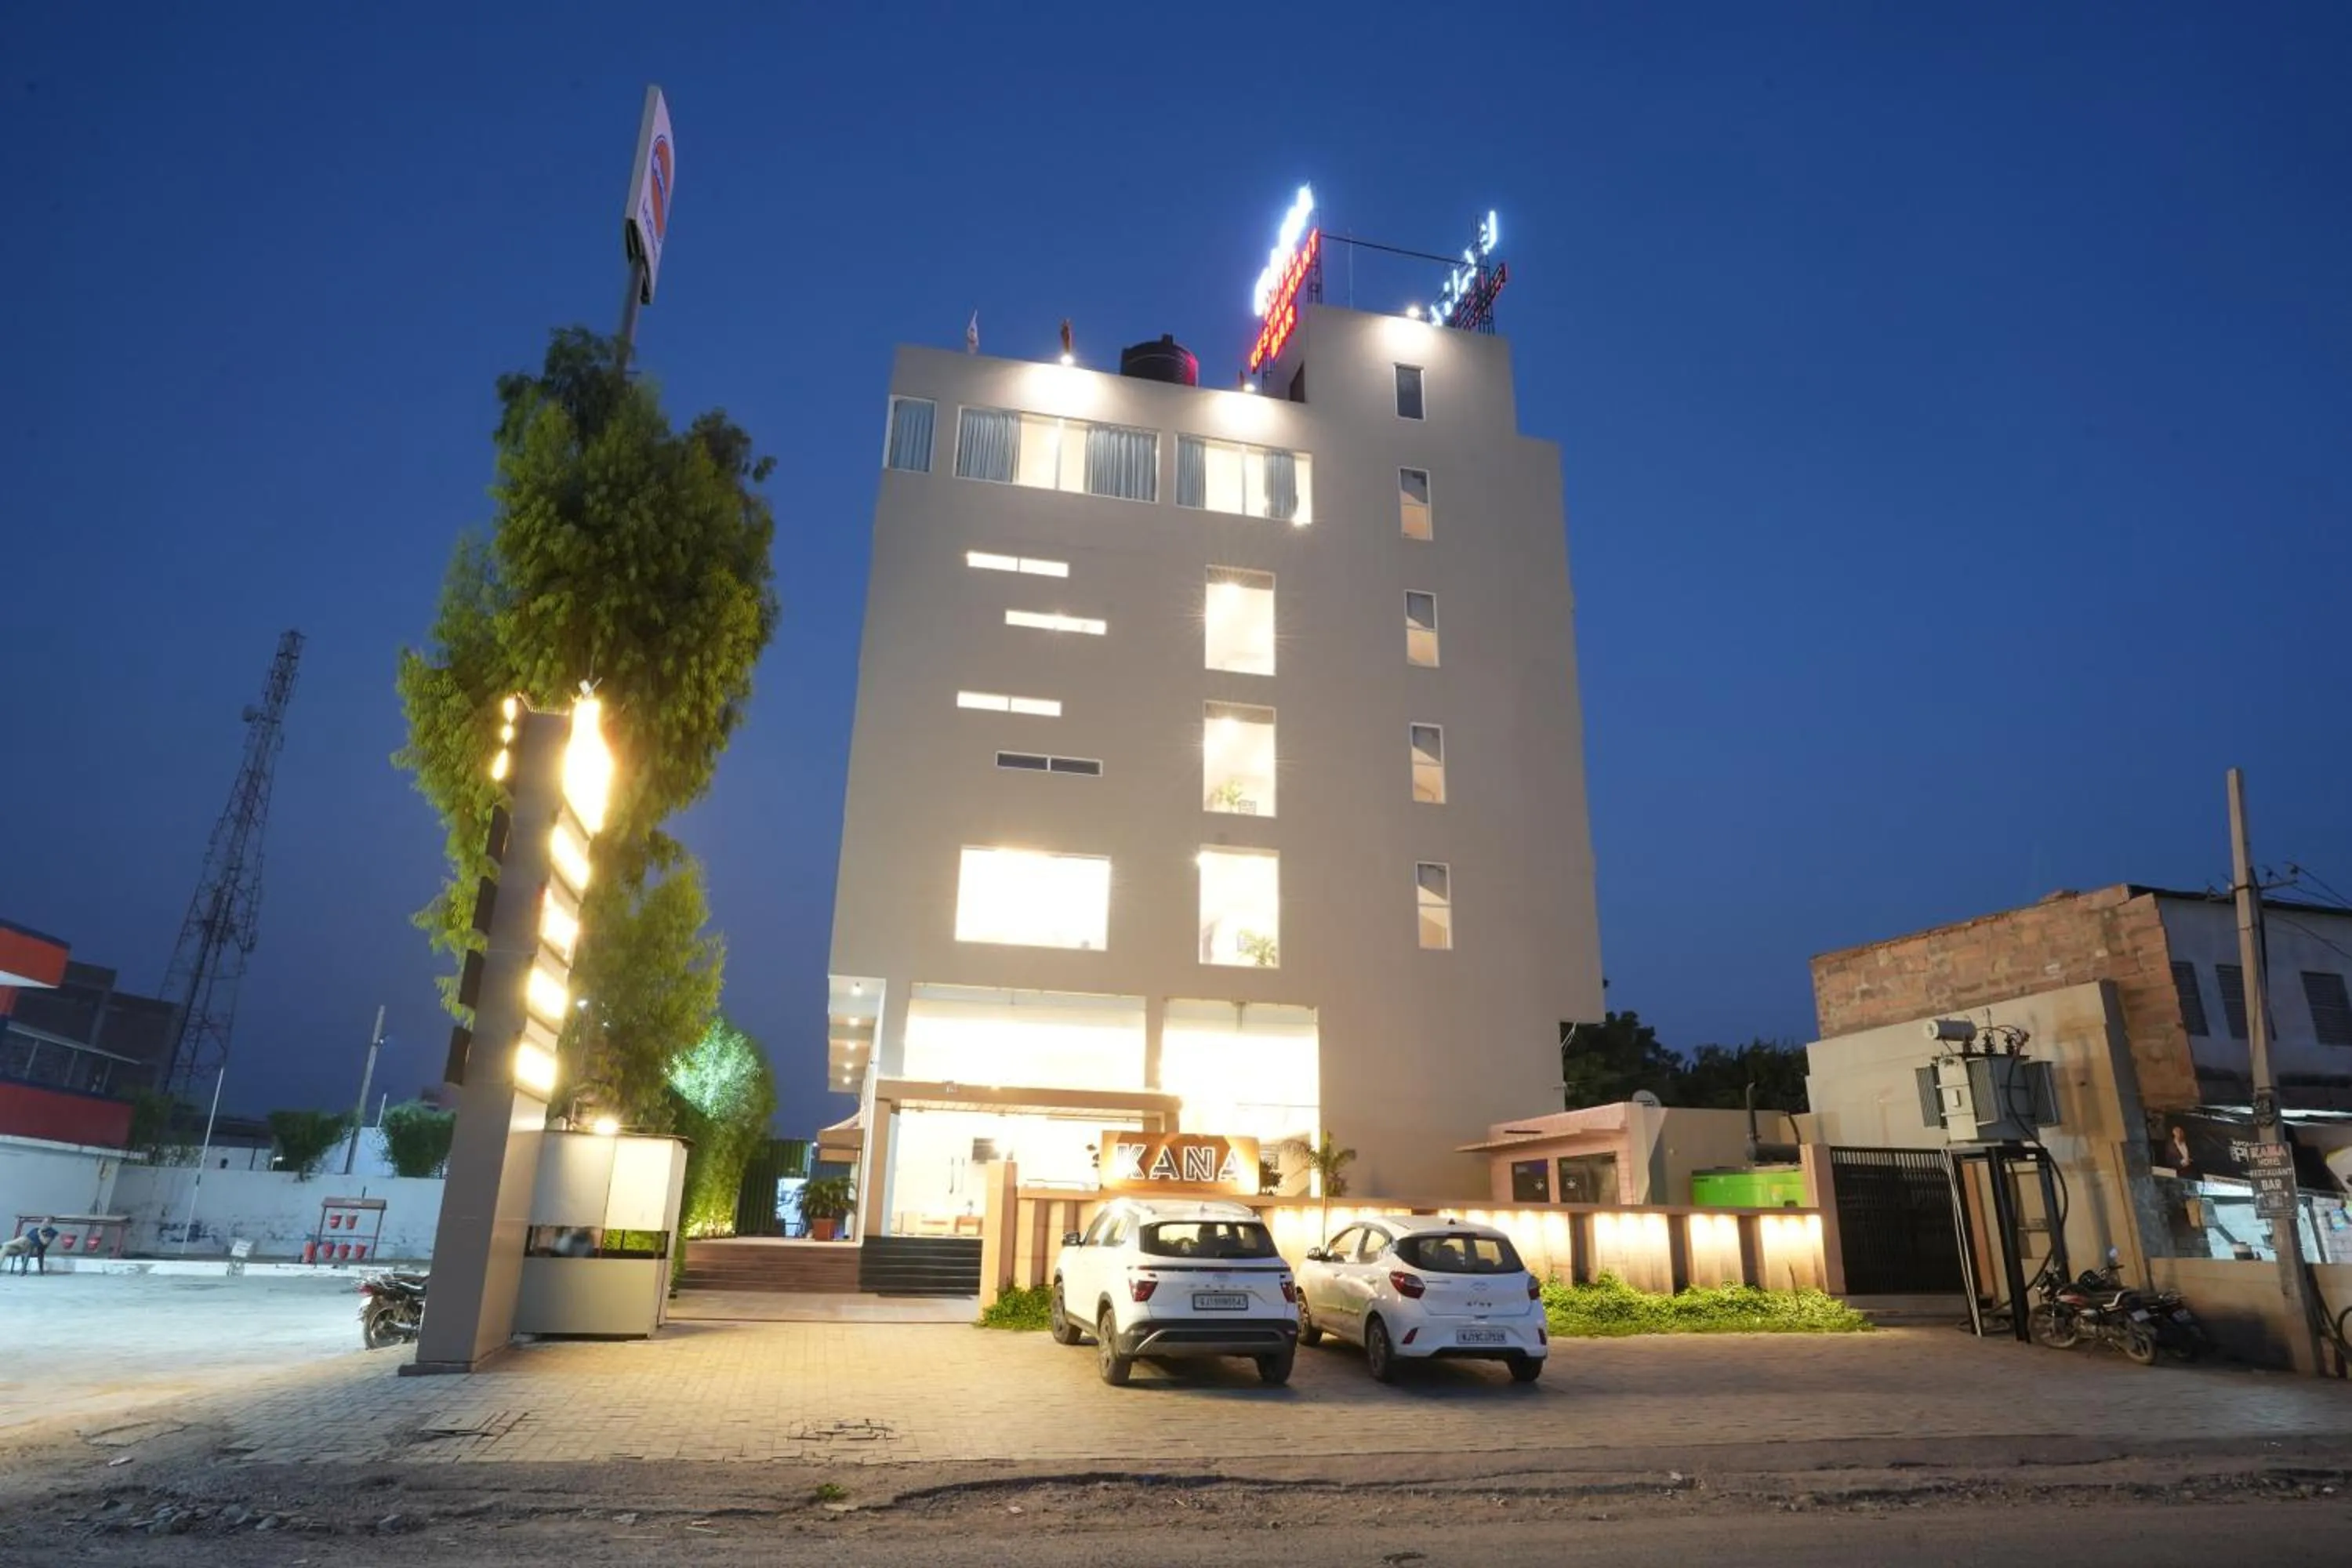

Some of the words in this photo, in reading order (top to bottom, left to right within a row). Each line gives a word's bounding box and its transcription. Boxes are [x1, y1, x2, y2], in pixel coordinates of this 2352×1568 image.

[1250, 226, 1318, 371] RESTAURANT
[1270, 304, 1294, 359] BAR
[1116, 1142, 1247, 1181] KANA
